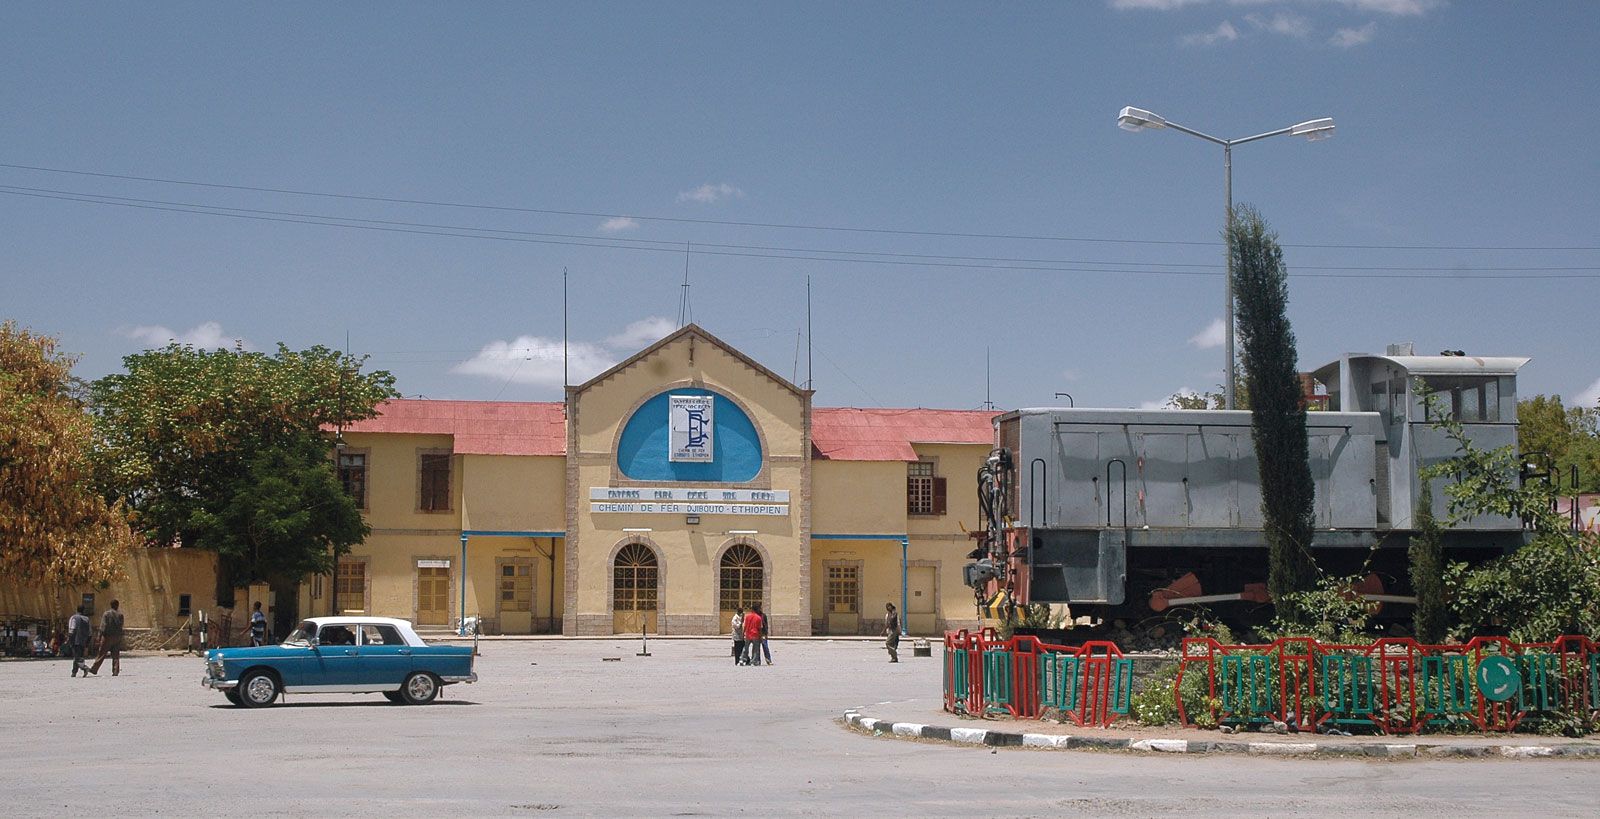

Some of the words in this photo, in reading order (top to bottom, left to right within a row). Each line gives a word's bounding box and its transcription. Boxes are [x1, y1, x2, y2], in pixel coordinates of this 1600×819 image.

[599, 504, 634, 512] CHEMIN
[641, 504, 653, 512] DE
[660, 504, 679, 512] FER
